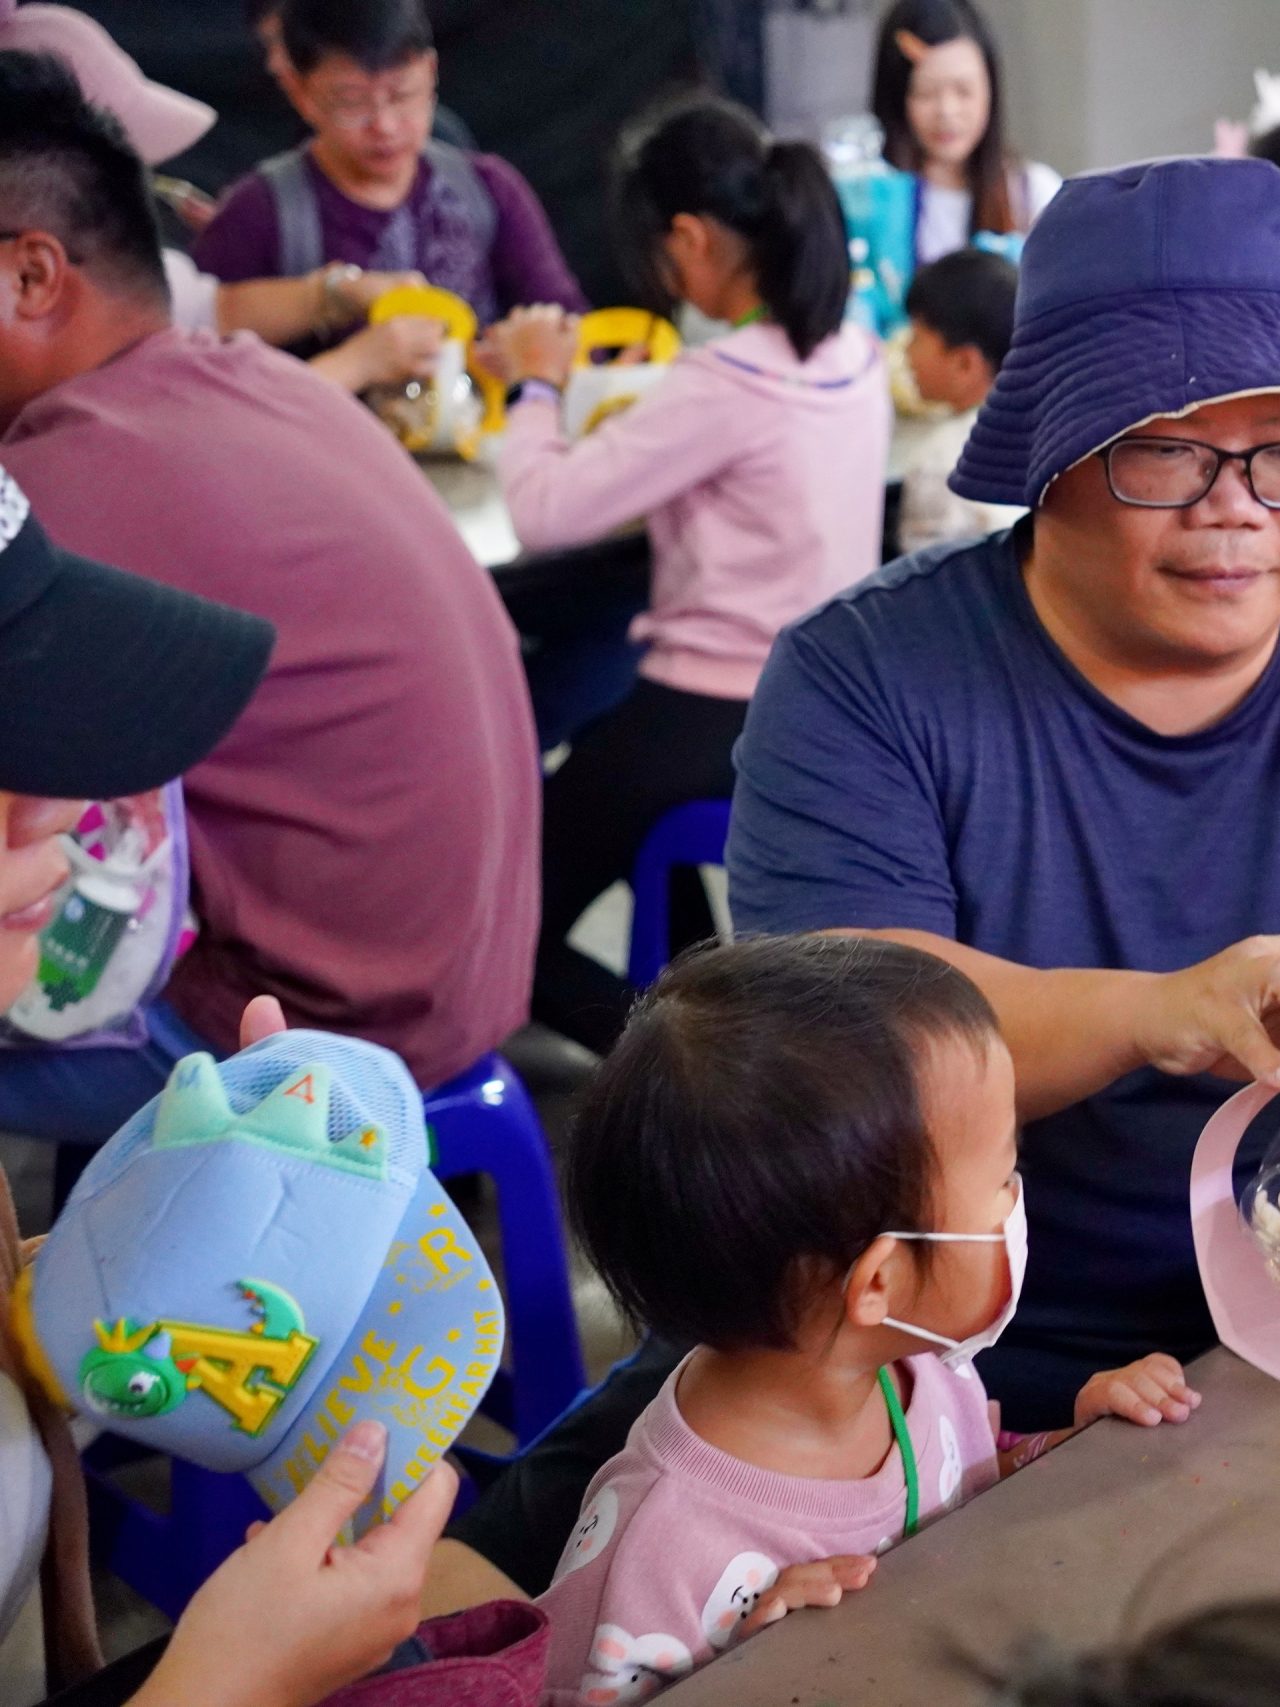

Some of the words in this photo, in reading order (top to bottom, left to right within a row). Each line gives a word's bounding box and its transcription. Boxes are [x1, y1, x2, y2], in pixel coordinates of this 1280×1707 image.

[418, 1226, 472, 1275] R
[473, 1310, 499, 1355] HAT
[155, 1319, 320, 1439] A
[402, 1344, 457, 1399] G
